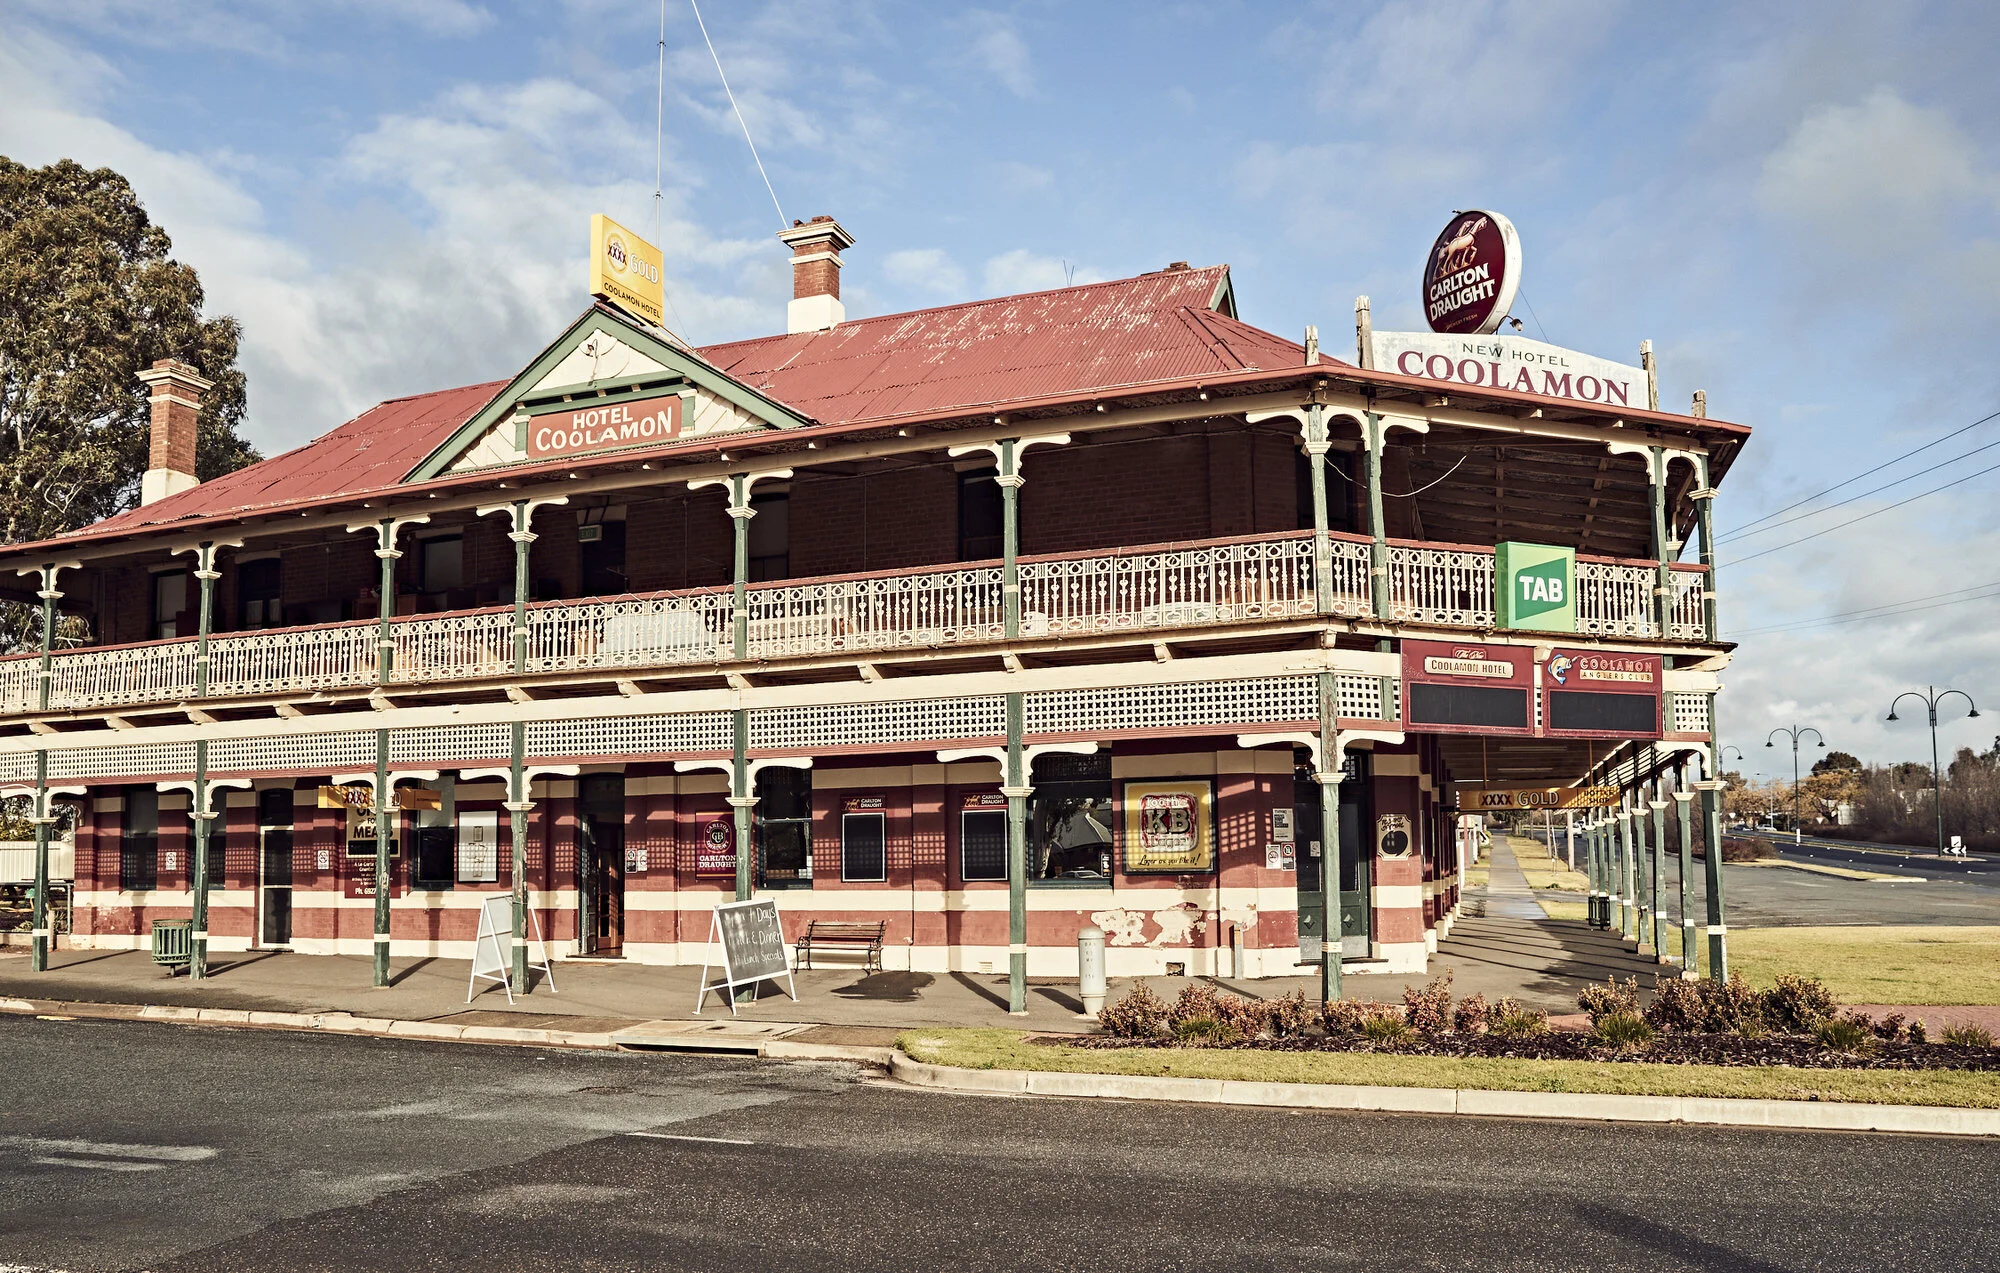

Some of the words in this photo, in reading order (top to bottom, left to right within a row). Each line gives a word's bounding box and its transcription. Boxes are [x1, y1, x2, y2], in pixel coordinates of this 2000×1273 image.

[607, 244, 627, 266] XXXX
[630, 254, 658, 284] GOLD
[1430, 263, 1490, 302] CARLTON
[603, 282, 640, 308] COOLAMON
[641, 303, 661, 319] HOTEL
[1429, 279, 1496, 322] DRAUGHT
[1462, 342, 1503, 358] NEW
[1512, 350, 1570, 368] HOTEL
[1397, 350, 1630, 407] COOLAMON
[535, 406, 672, 451] COOLAMON
[572, 406, 634, 430] HOTEL
[1519, 575, 1564, 602] TAB
[1431, 659, 1479, 673] COOLAMON
[1482, 664, 1507, 675] HOTEL
[1580, 658, 1652, 672] COOLAMON
[1582, 671, 1624, 680] ANGLERS
[1628, 673, 1652, 681] CLUB
[1481, 793, 1513, 806] XXXX
[1517, 790, 1560, 806] GOLD
[353, 826, 393, 838] MEA
[706, 823, 729, 834] CARLTON
[1145, 808, 1191, 835] KB
[756, 907, 776, 928] Days
[758, 930, 781, 945] Dinner
